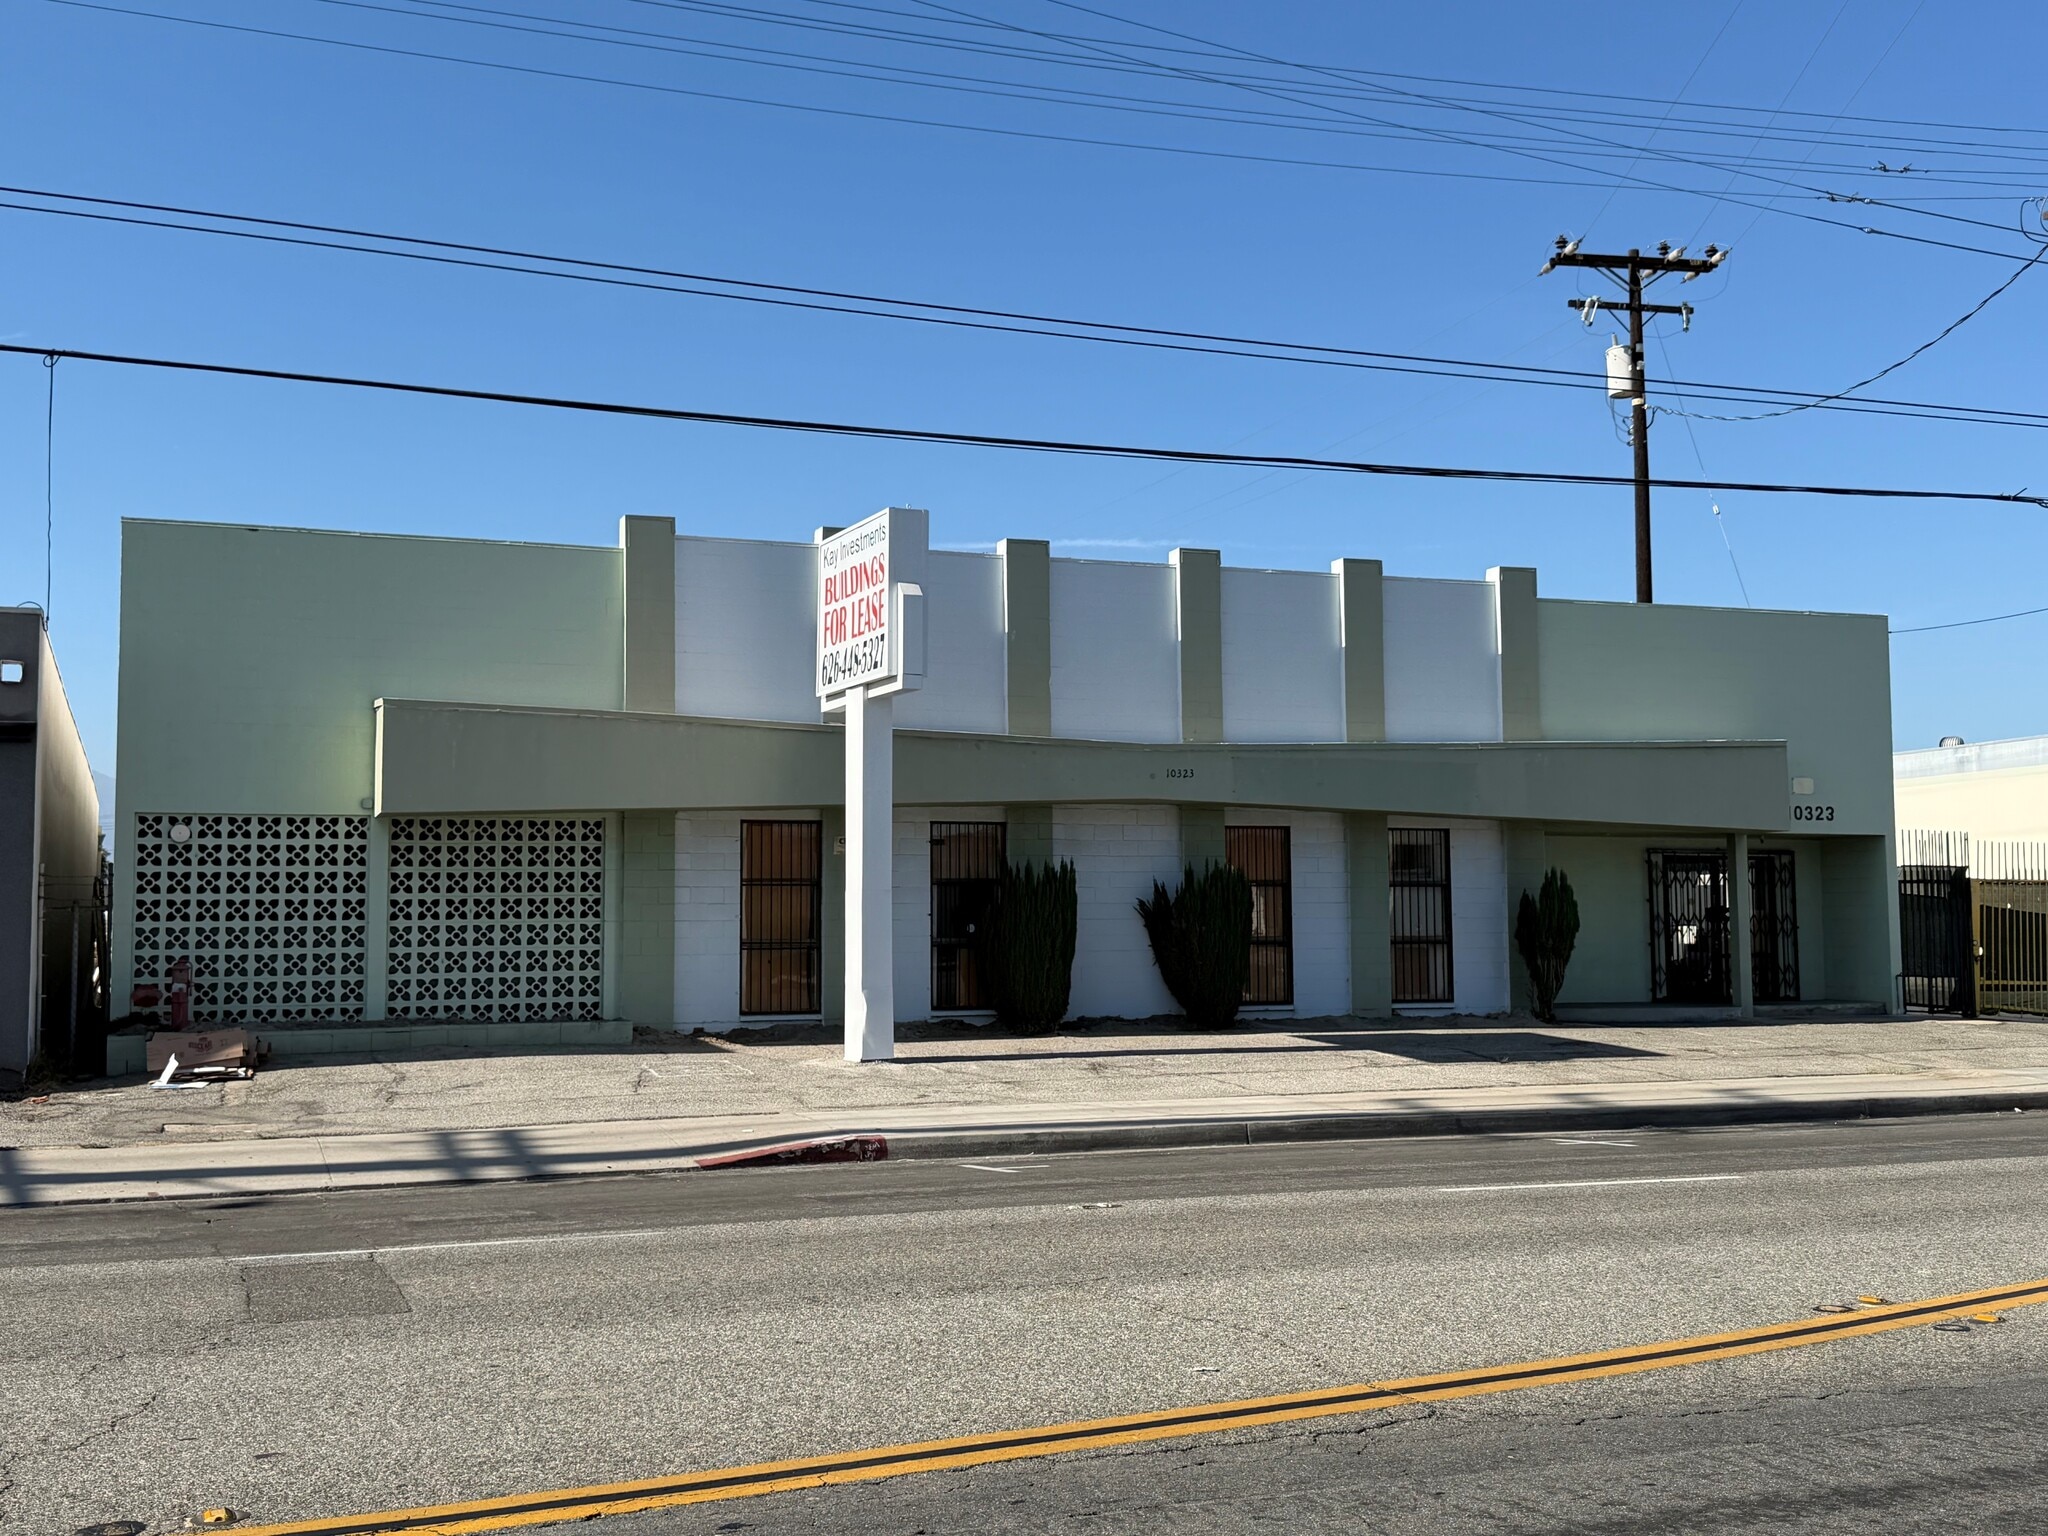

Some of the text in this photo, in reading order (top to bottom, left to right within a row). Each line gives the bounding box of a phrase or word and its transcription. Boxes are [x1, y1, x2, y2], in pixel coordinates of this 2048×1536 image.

[823, 523, 887, 569] Kay Investments
[825, 552, 885, 606] BUILDINGS
[824, 588, 885, 649] FOR LEASE
[822, 633, 885, 687] 626-448-5327
[1166, 768, 1194, 779] 10323
[1789, 805, 1835, 821] 0323
